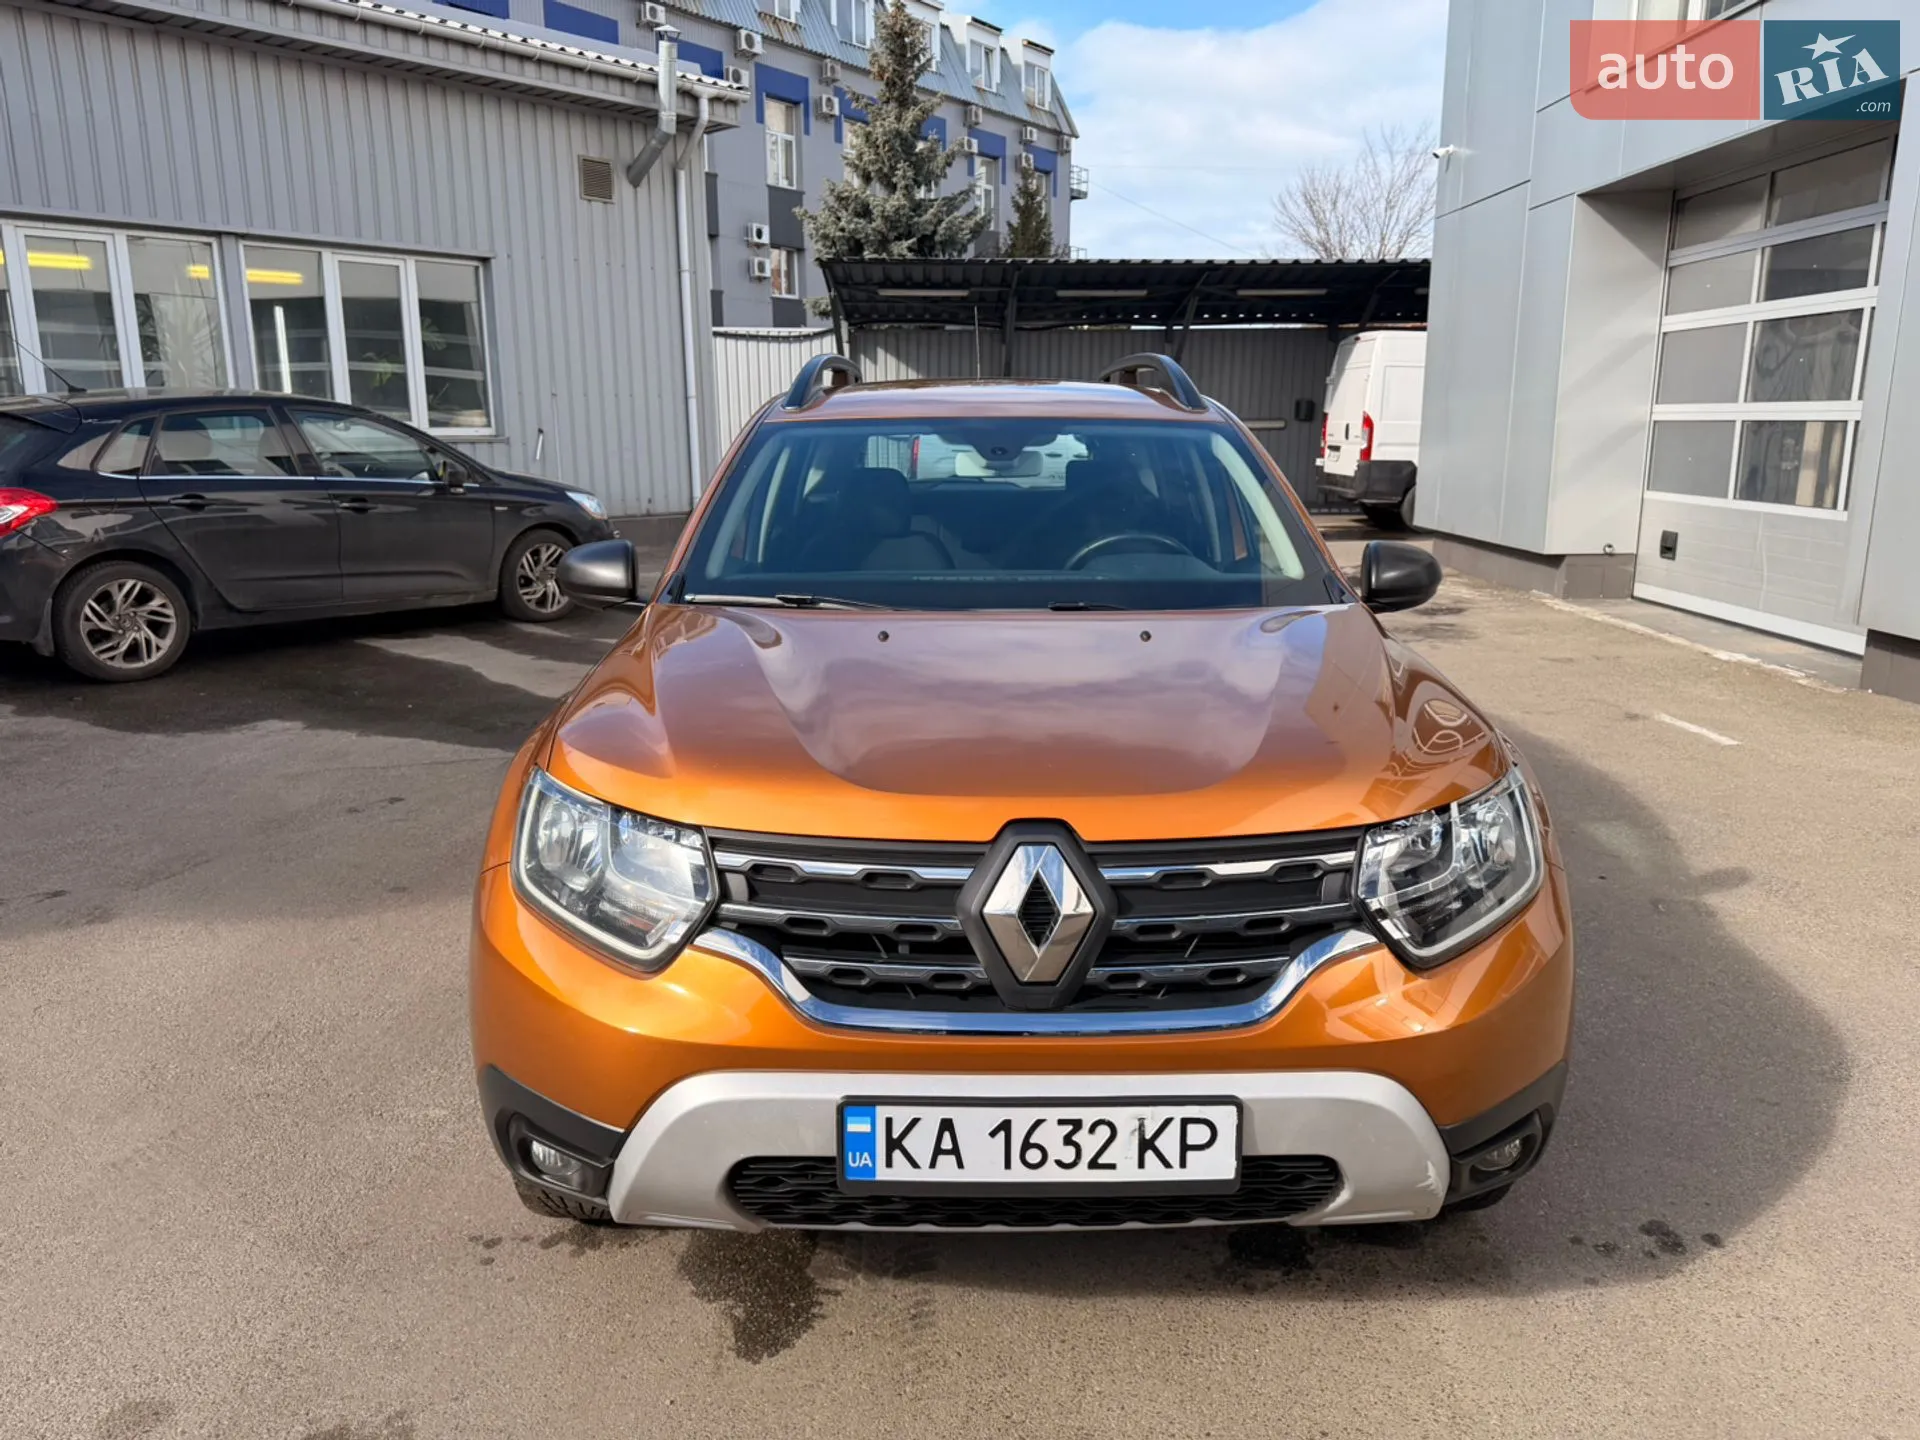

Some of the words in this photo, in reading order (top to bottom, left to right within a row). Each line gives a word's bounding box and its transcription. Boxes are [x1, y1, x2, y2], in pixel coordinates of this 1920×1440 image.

[848, 1152, 873, 1167] UA
[885, 1116, 965, 1170] KA
[988, 1118, 1118, 1170] 1632
[1137, 1117, 1219, 1169] KP
